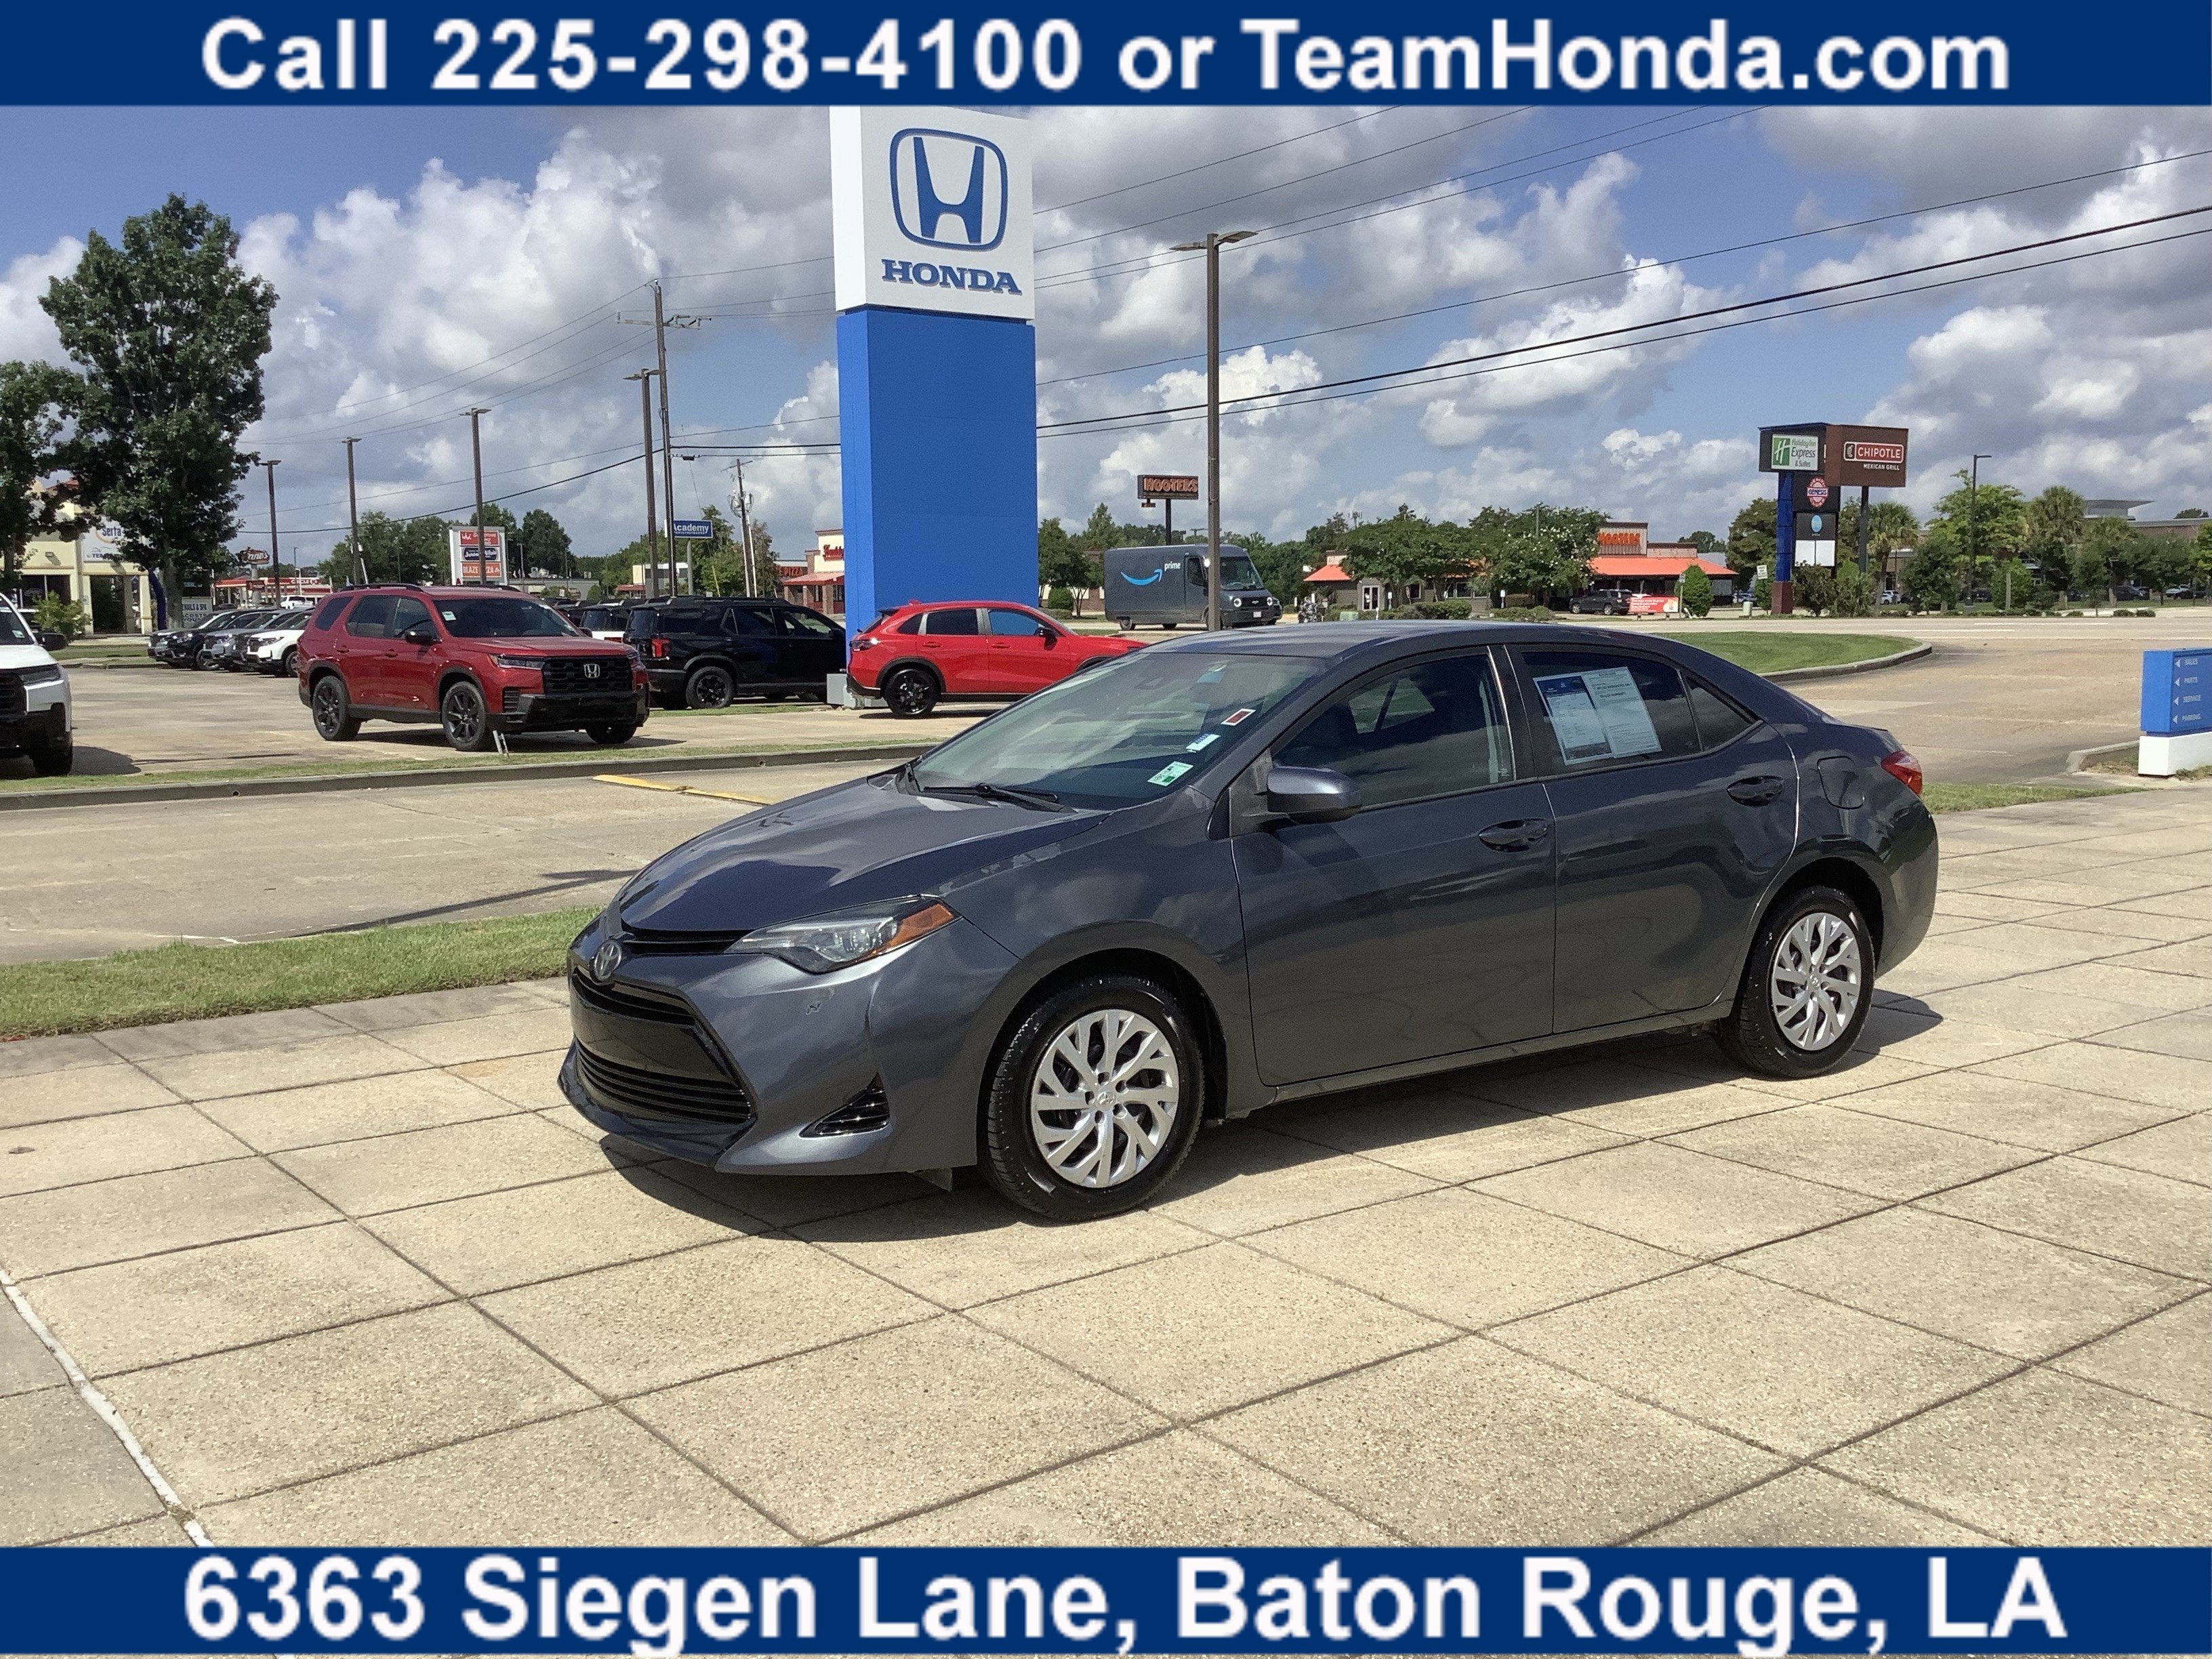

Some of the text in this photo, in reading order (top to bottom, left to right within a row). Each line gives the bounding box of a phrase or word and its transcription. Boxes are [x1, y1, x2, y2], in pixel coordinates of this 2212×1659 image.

[881, 258, 1023, 296] HONDA
[1791, 447, 1816, 459] Express
[1858, 447, 1902, 459] CHIPOTLE
[1143, 477, 1197, 492] HOOTERS
[102, 527, 121, 536] Serta
[1164, 560, 1181, 571] prime
